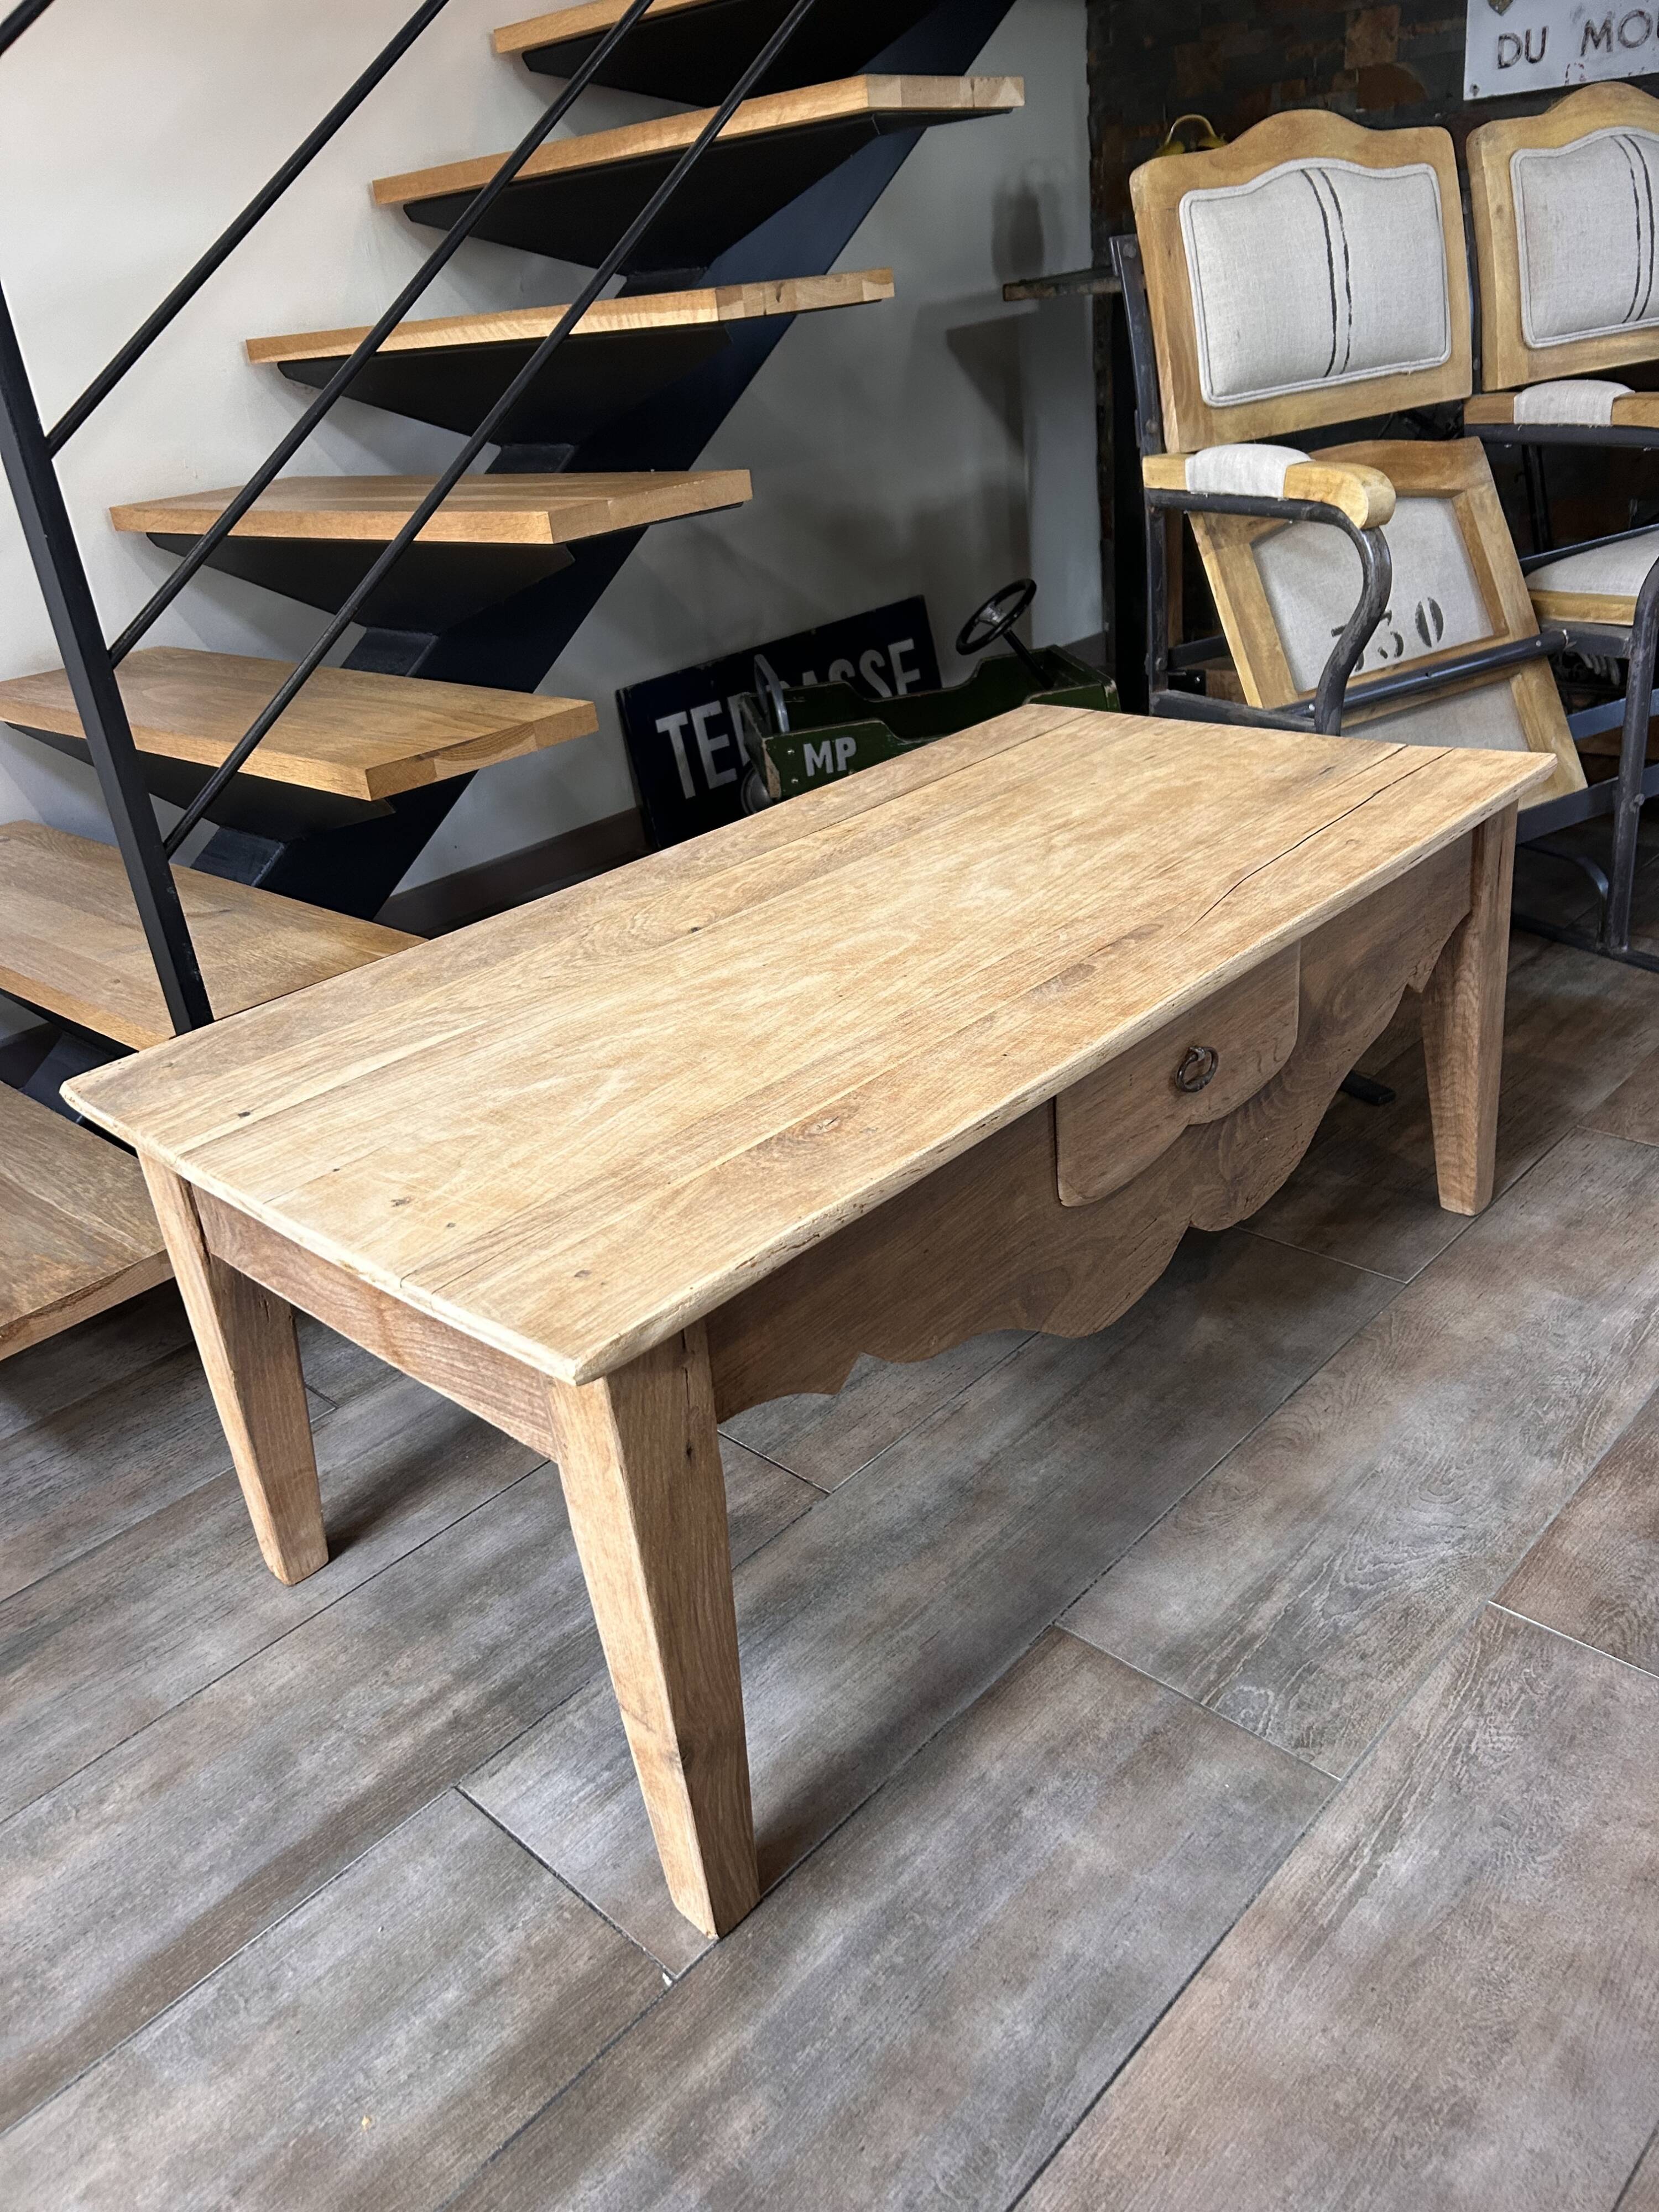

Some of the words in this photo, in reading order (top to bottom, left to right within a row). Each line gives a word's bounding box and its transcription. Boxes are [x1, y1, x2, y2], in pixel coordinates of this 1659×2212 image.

[1497, 26, 1548, 69] DU
[1580, 8, 1659, 56] MO
[803, 737, 858, 777] MP
